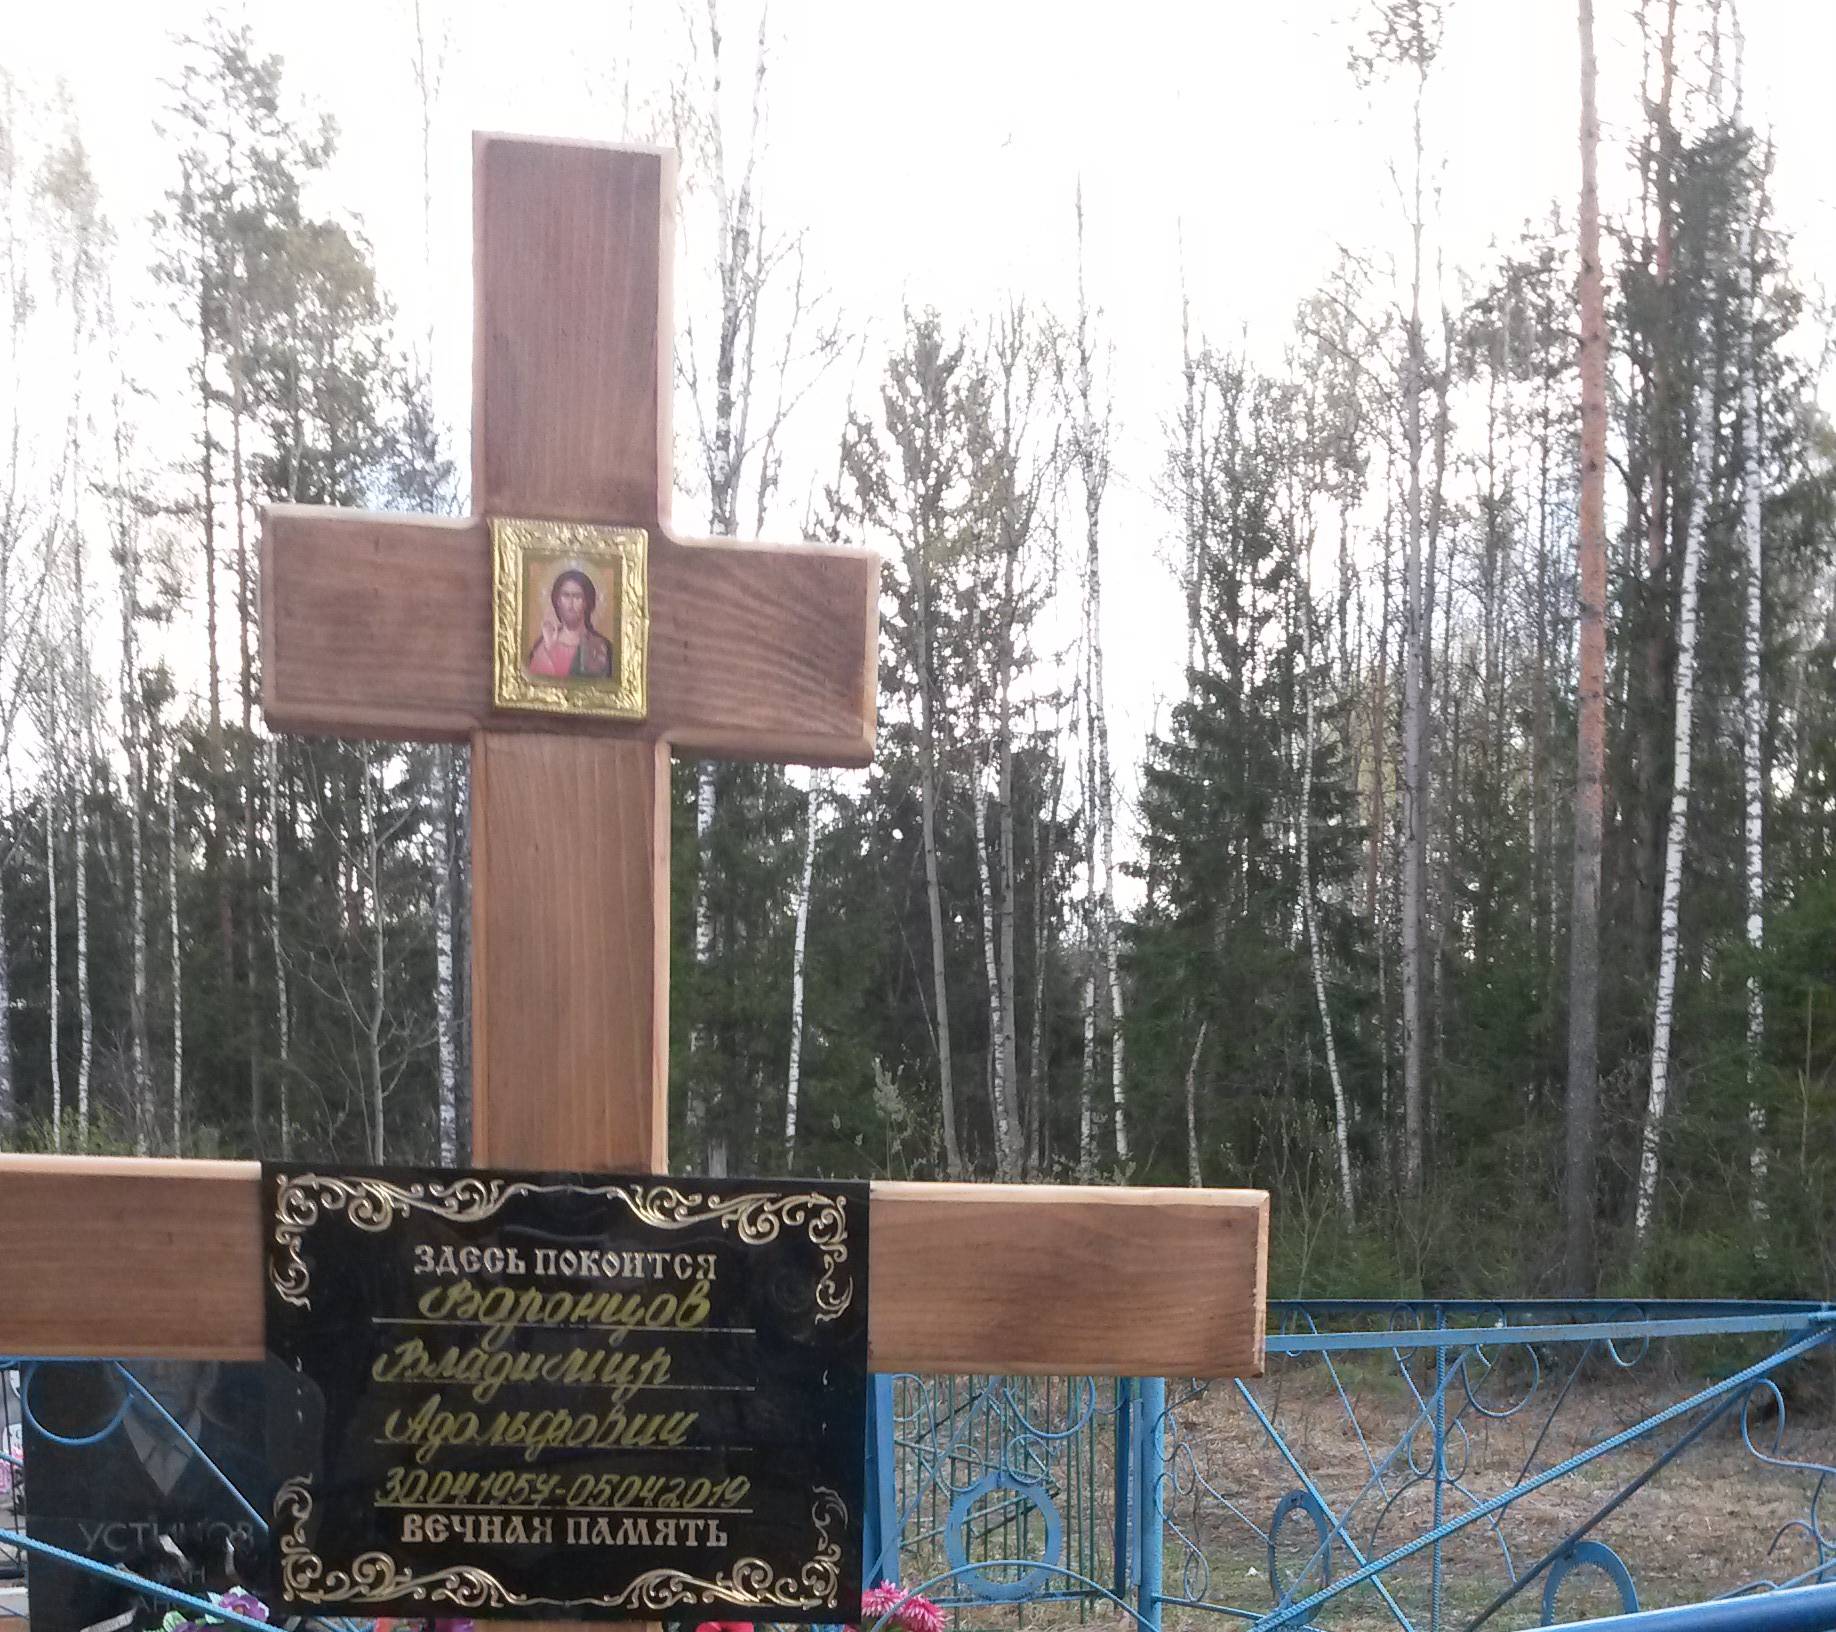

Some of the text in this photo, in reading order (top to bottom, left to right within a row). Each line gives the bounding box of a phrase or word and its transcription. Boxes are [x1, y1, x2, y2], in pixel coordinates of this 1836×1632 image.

[414, 1244, 717, 1281] ЗДЕСЬ ПОКОИТСЯ
[418, 1279, 711, 1350] Воронцов
[372, 1337, 672, 1403] Владимир
[384, 1393, 699, 1464] Адольфович
[401, 1513, 728, 1547] ВЕЧНАЯ ПАМЯТЬ
